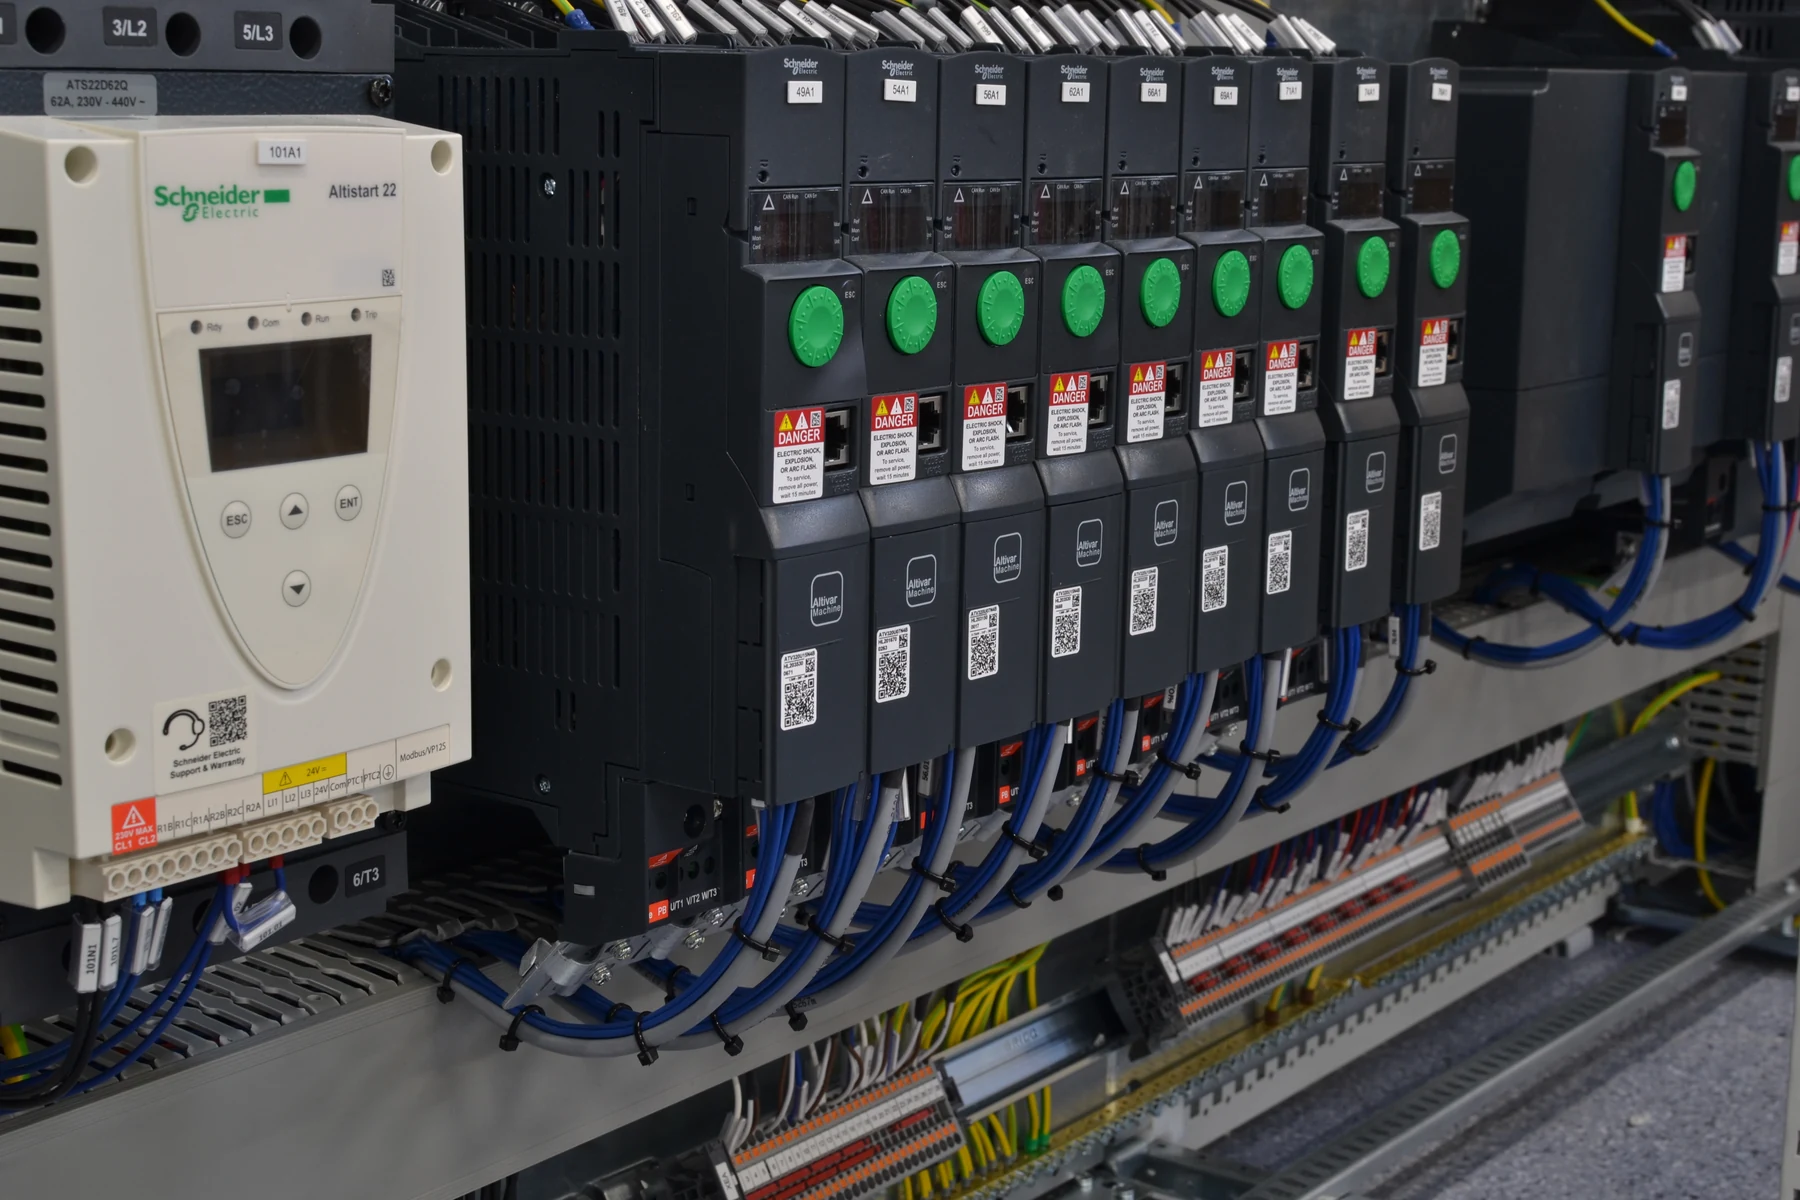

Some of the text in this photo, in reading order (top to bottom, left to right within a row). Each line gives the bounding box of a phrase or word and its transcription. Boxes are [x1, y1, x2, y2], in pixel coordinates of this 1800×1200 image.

[112, 19, 147, 36] 3/L2
[243, 25, 273, 41] 5/L3
[784, 58, 818, 68] Schneider
[882, 60, 913, 70] Schneider
[67, 79, 128, 91] ATS22D62Q
[893, 85, 909, 95] 54A1
[796, 87, 814, 97] 49A1
[984, 90, 999, 100] 56A1
[1069, 88, 1083, 96] 62A1
[51, 96, 136, 108] 62A, 230V 440V
[270, 146, 301, 159] 101A1
[154, 185, 260, 206] Schneider
[329, 184, 396, 198] Altistart 22
[202, 206, 259, 219] Electric
[207, 310, 377, 332] Rdy Com Run Trip
[1269, 357, 1295, 369] DANGER
[1204, 366, 1231, 379] DANGER
[1132, 380, 1162, 393] DANGER
[1053, 391, 1086, 403] DANGER
[968, 402, 1003, 416] DANGER
[876, 414, 913, 428] DANGER
[779, 429, 820, 444] DANGER
[973, 427, 997, 435] EXPLOSION,
[777, 447, 821, 457] ELECTRIC SHOCK,
[785, 456, 814, 464] EXPLOSION,
[340, 497, 358, 509] ENT
[227, 514, 247, 526] ESC
[1078, 540, 1098, 550] Altivar
[996, 554, 1017, 566] Altivar
[996, 563, 1019, 574] Machine
[909, 577, 931, 589] Altivar
[909, 586, 934, 598] Machine
[813, 595, 838, 608] Altivar
[813, 604, 840, 616] Machine
[173, 748, 240, 768] Schneider Electric
[400, 742, 446, 762] Modbus/VP12S
[170, 757, 245, 779] Support & Warrantly
[307, 766, 320, 777] 24V
[1002, 791, 1008, 799] PB
[158, 822, 173, 832] R1B
[175, 818, 191, 829] R1C
[193, 815, 208, 825] R1A
[210, 811, 225, 821] R2B
[227, 806, 242, 816] R2C
[246, 802, 261, 812] R2A
[315, 786, 328, 795] 24V
[330, 782, 346, 791] Com
[348, 776, 363, 786] PTC1
[364, 772, 380, 782] PTC2
[116, 826, 153, 840] 230V MAX
[115, 835, 156, 850] CL1 CL2
[353, 867, 380, 887] 6/T3
[658, 888, 717, 916] PB U/T1 V/T2 W/T3
[259, 920, 283, 941] 101.01
[86, 944, 97, 974] 101N1
